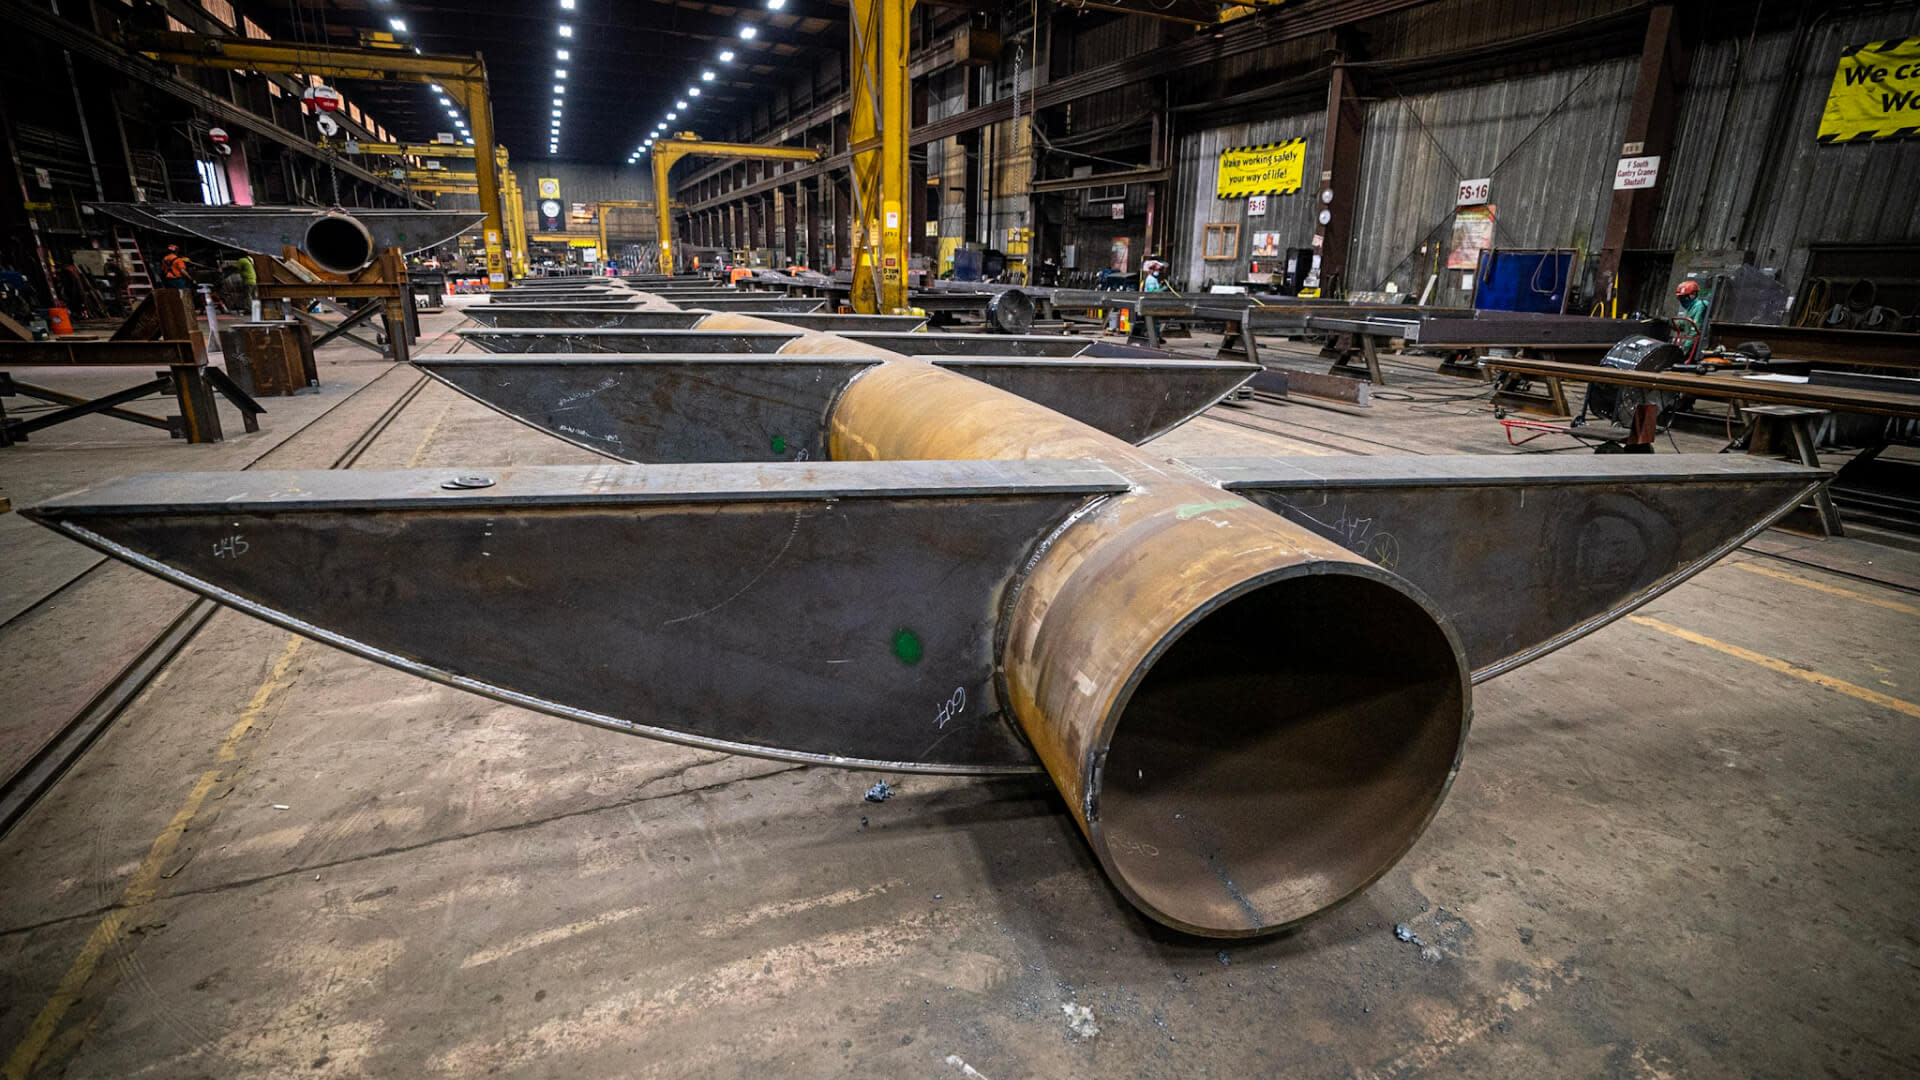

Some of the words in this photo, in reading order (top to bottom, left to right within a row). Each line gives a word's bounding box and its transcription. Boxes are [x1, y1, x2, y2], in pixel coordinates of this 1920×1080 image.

[1845, 64, 1888, 86] We
[1243, 155, 1272, 166] working
[1274, 151, 1298, 163] safely
[1229, 175, 1245, 186] your
[1246, 174, 1260, 183] way
[1262, 170, 1271, 180] of
[1272, 168, 1287, 179] life!
[1458, 184, 1488, 200] FS-16
[1249, 200, 1266, 211] FS-15
